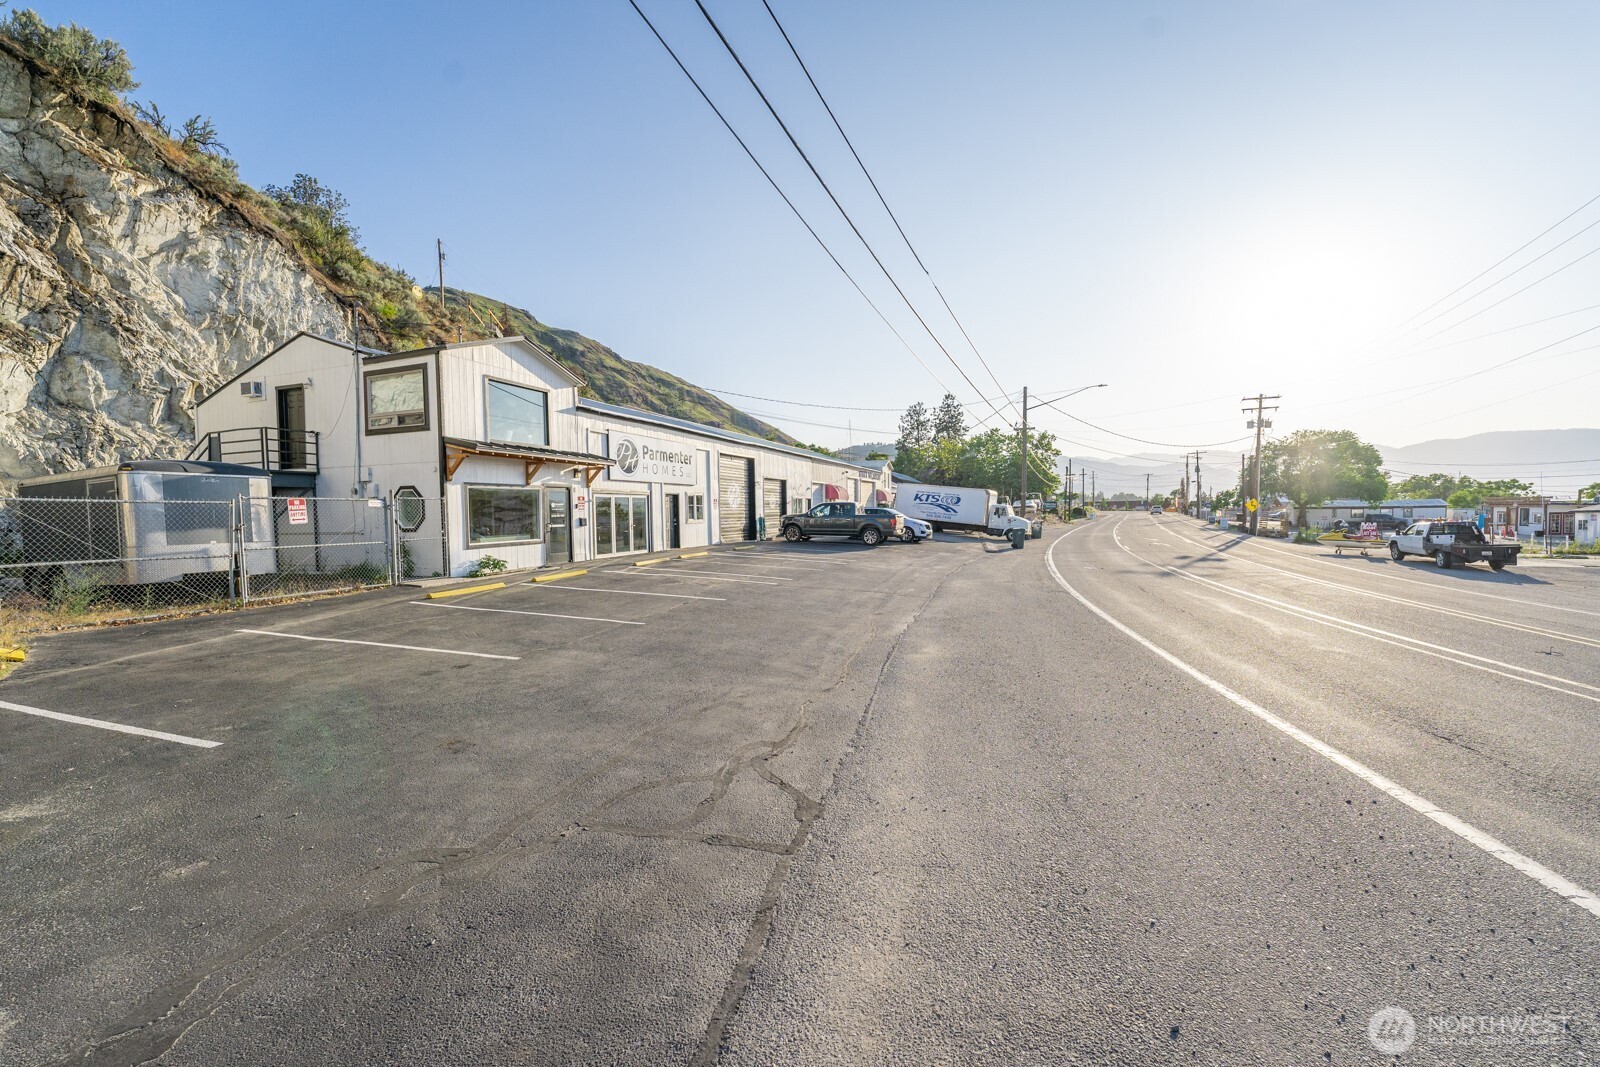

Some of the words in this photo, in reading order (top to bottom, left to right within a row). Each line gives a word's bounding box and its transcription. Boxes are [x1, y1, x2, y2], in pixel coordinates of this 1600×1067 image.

[642, 444, 693, 465] Parmenter
[642, 462, 684, 478] HOMES
[913, 493, 941, 503] KTS
